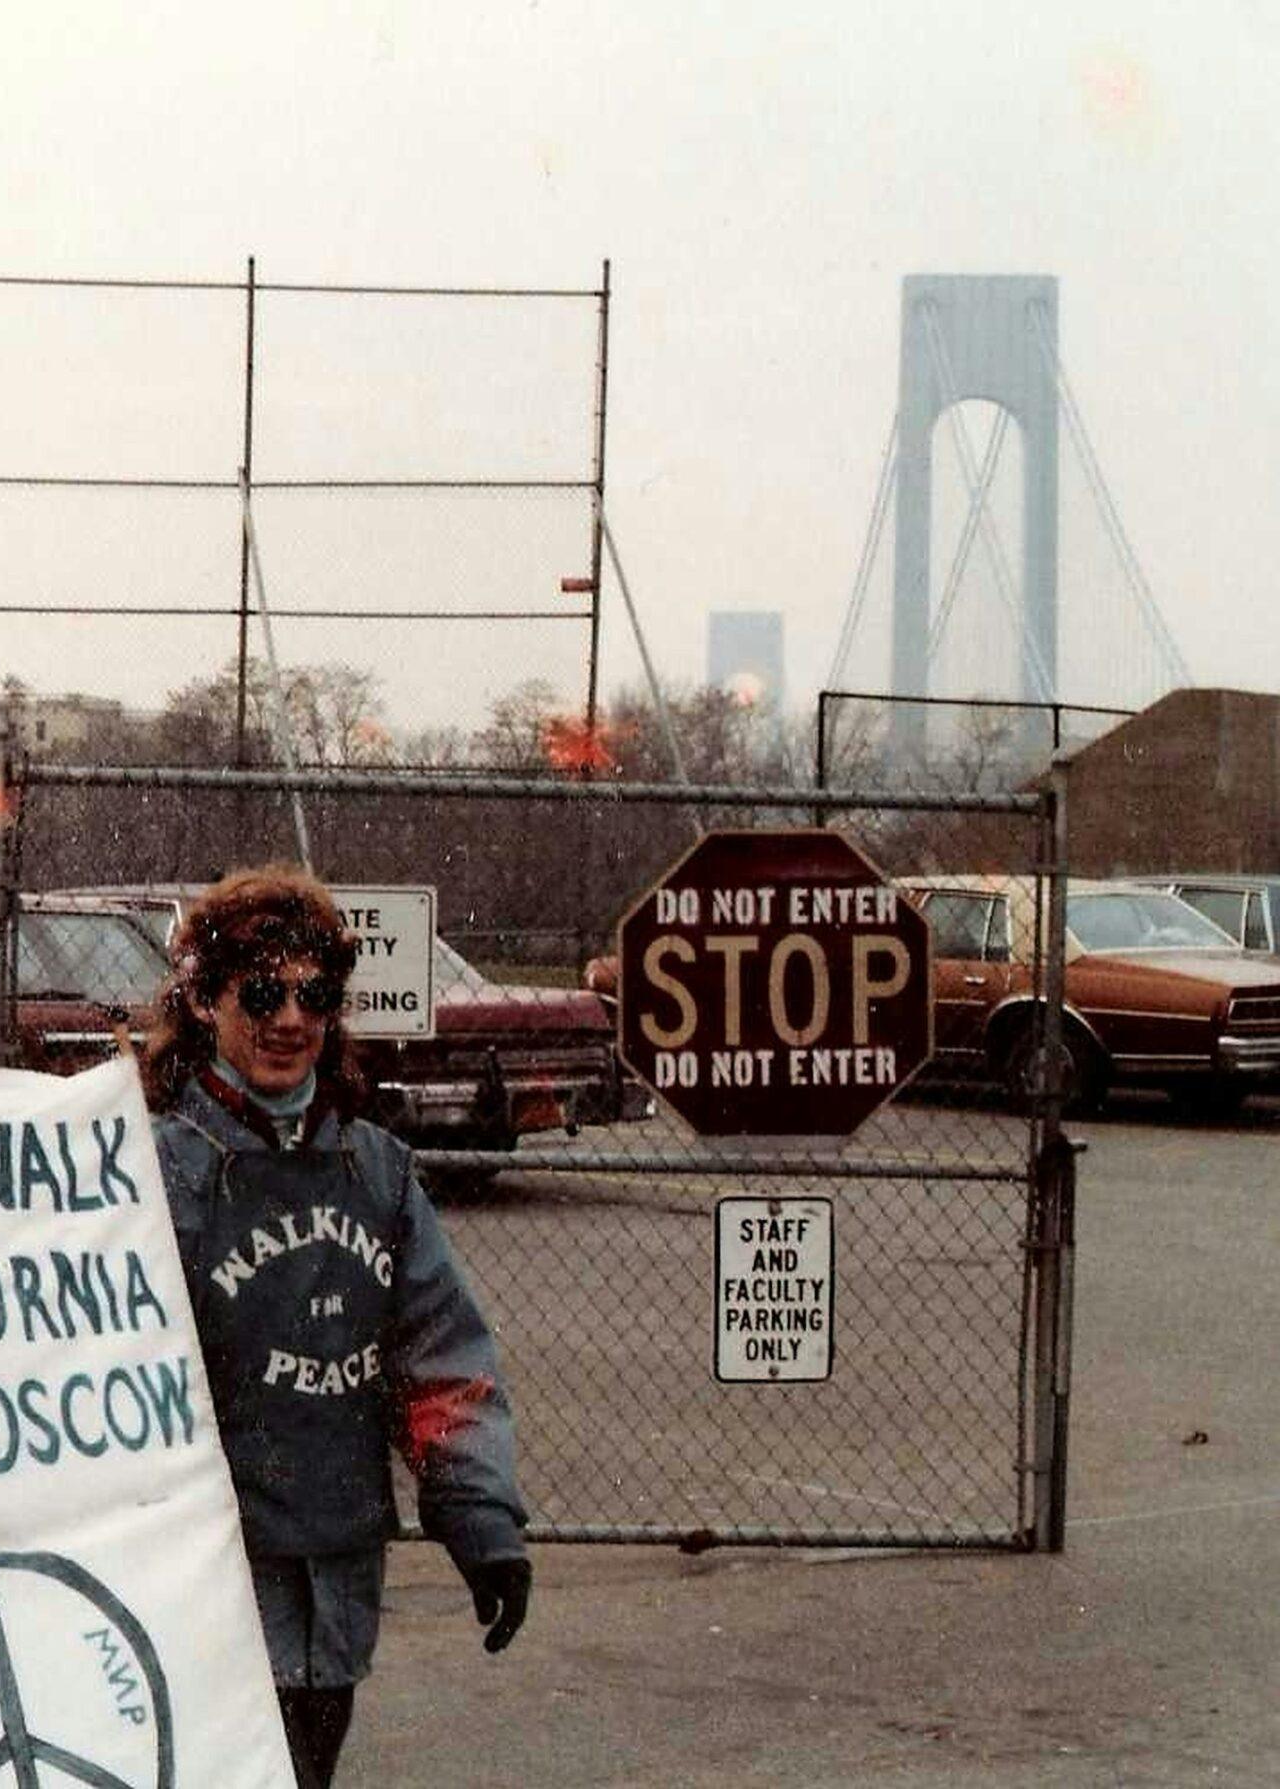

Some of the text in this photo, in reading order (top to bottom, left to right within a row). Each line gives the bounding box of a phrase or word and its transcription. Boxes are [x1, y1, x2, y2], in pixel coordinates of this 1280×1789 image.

[656, 886, 898, 925] DO NOT ENTER
[639, 933, 911, 1048] STOP
[655, 1048, 897, 1088] DO NOT ENTER
[740, 1218, 810, 1243] STAFF
[210, 1205, 394, 1298] WALKING
[752, 1250, 798, 1272] AND
[724, 1278, 824, 1301] FACULTY
[726, 1308, 823, 1331] PARKING
[746, 1338, 801, 1361] ONLY
[263, 1343, 382, 1395] PEACE
